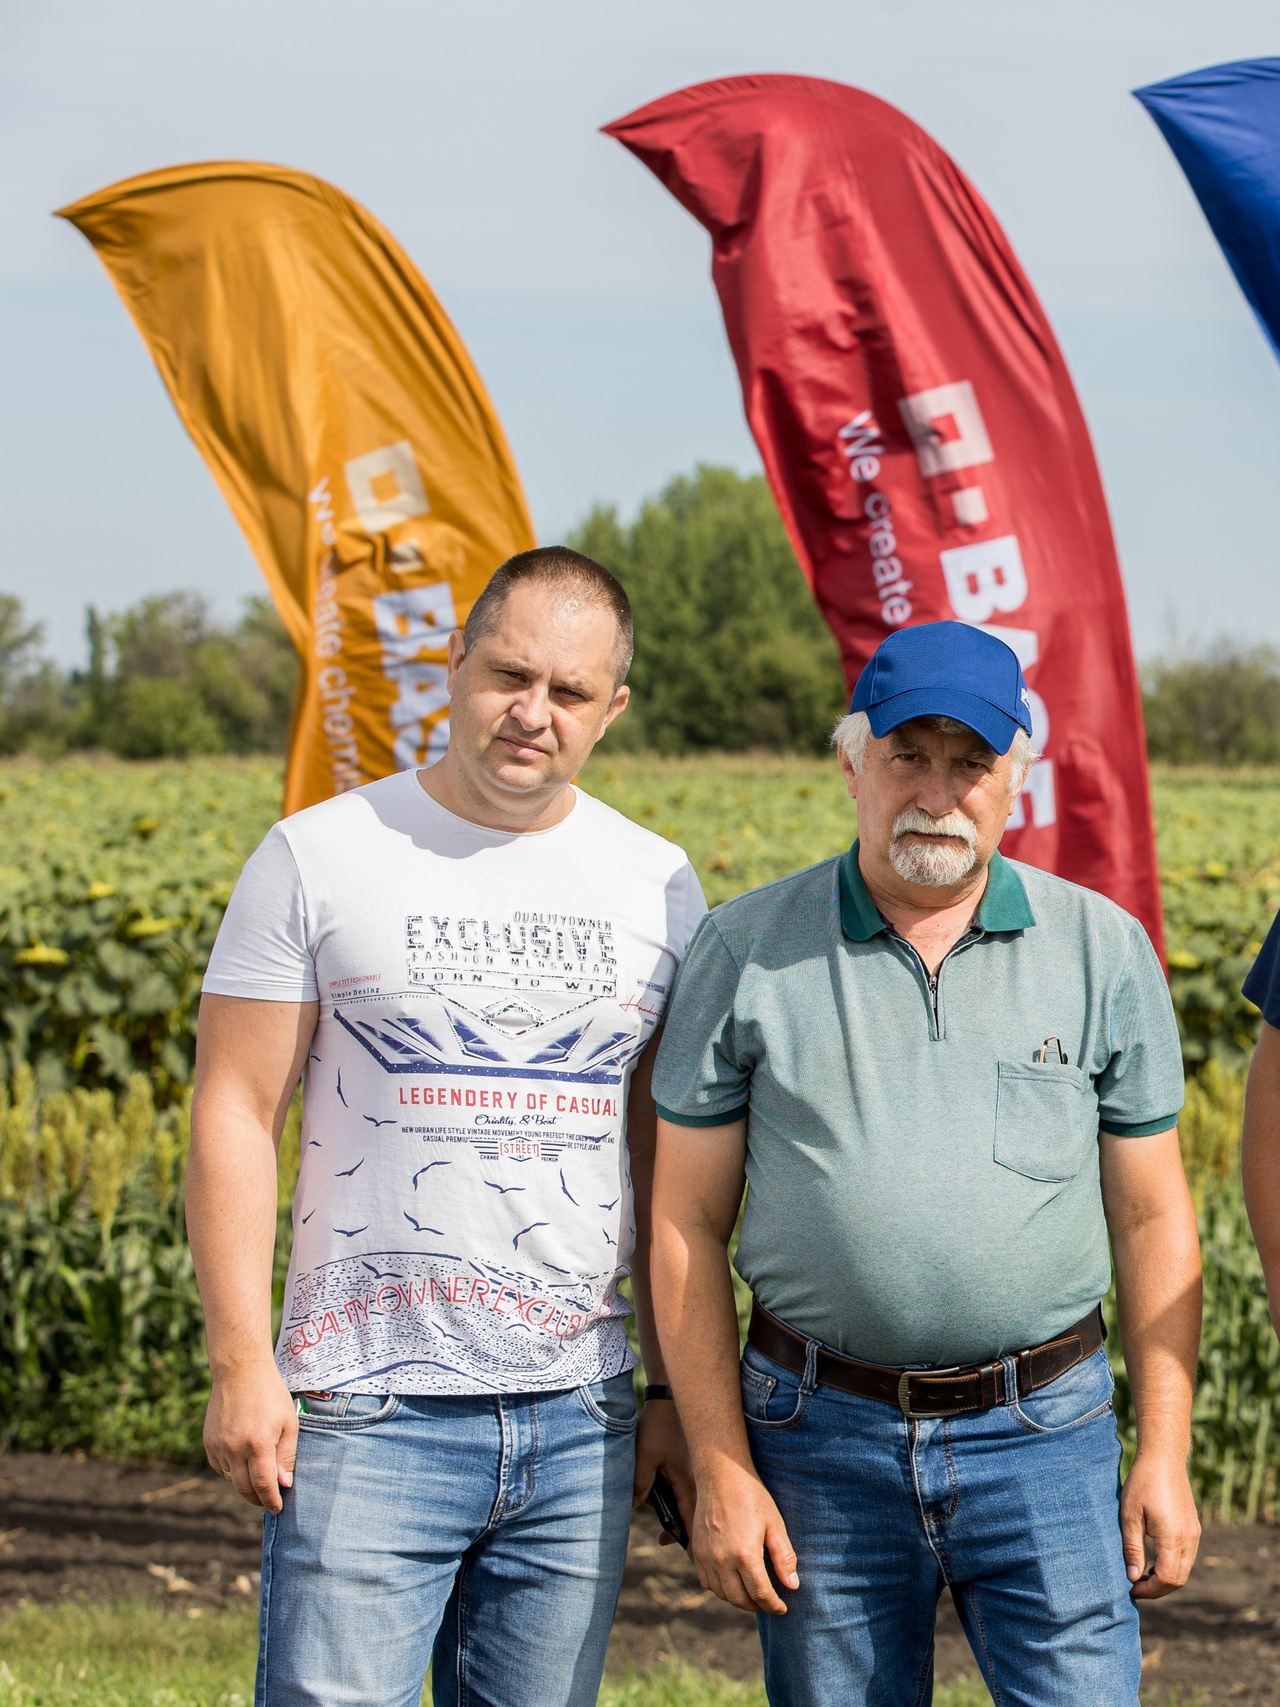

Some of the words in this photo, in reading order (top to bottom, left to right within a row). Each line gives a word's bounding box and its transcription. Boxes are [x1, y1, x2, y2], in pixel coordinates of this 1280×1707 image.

[838, 411, 885, 483] We
[864, 493, 913, 625] create
[405, 915, 617, 966] EXCLUSIVE
[412, 951, 494, 966] FASHION
[415, 971, 482, 983] BORN
[513, 977, 540, 988] TO
[566, 981, 613, 994] WIN
[331, 990, 352, 999] Simple
[400, 1087, 518, 1109] LEGENDERY
[527, 1093, 548, 1110] OF
[556, 1095, 618, 1116] CASUAL
[531, 1115, 560, 1126] Best
[448, 1127, 465, 1135] STYLE
[467, 1128, 491, 1136] VINTAGE
[574, 1142, 588, 1150] STYLE
[289, 1294, 370, 1356] QUALITY
[376, 1276, 490, 1312] OWNER
